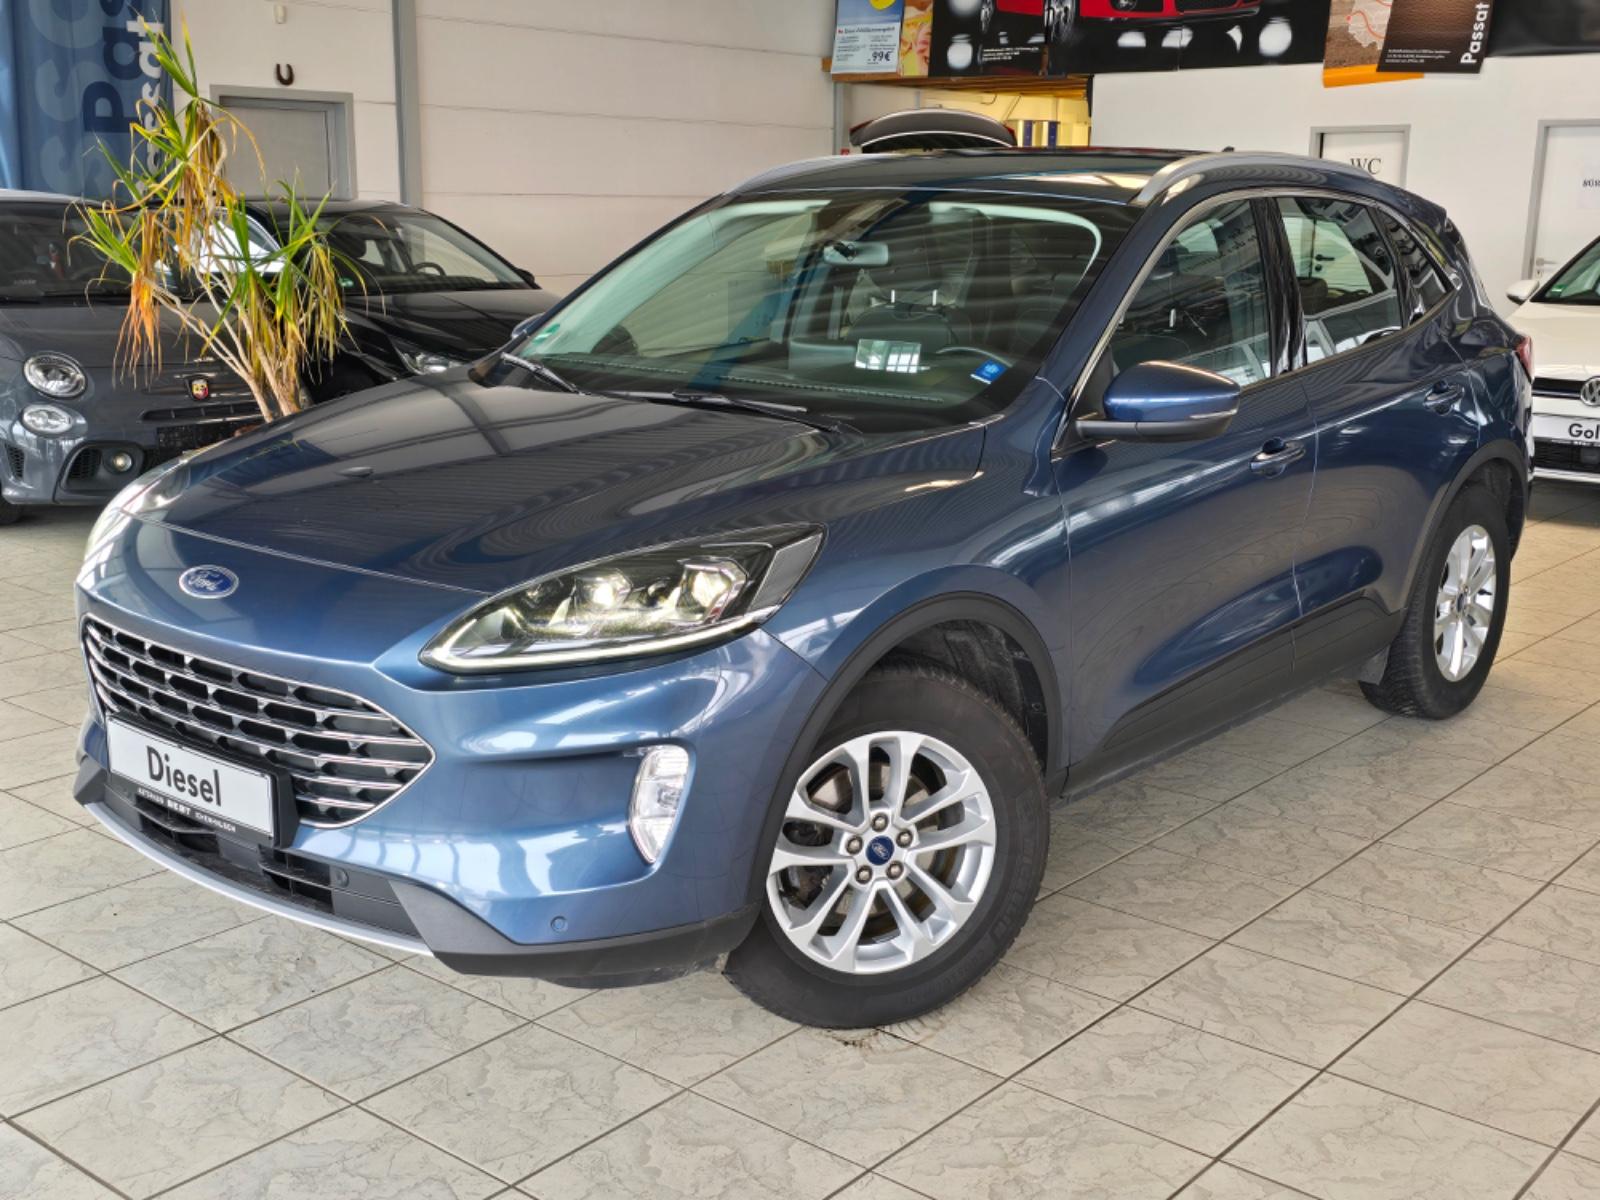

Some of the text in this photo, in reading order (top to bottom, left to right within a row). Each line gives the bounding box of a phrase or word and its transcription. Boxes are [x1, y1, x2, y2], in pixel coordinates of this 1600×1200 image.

[1460, 2, 1490, 64] Passat
[1350, 157, 1382, 175] WC
[1568, 423, 1600, 440] Gol
[146, 745, 222, 806] Diesel
